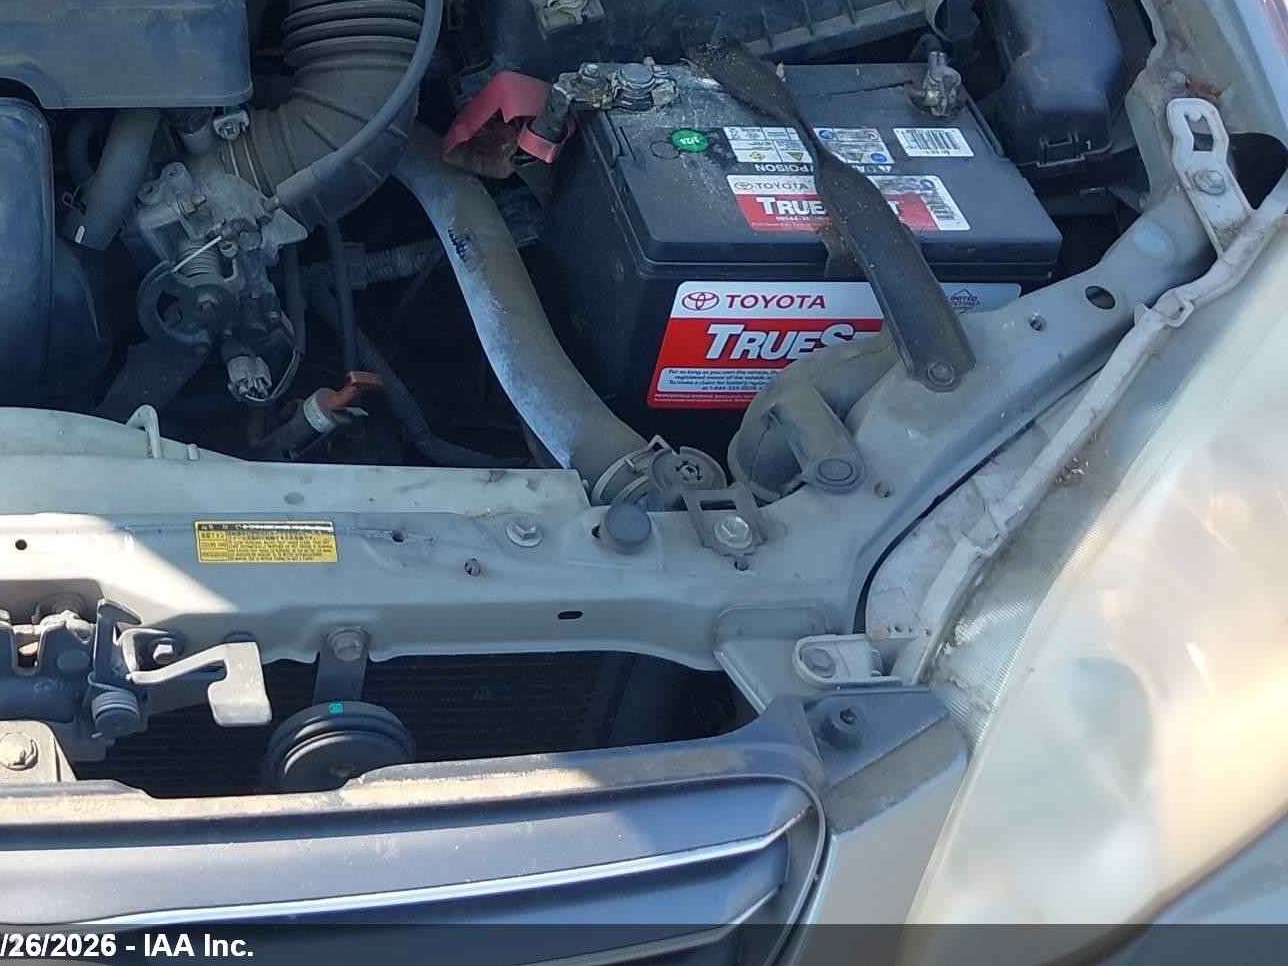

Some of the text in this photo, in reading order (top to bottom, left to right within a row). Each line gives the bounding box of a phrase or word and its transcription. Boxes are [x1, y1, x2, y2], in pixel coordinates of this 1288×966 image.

[753, 182, 809, 190] TOYOTA
[756, 197, 826, 215] TRUE
[725, 294, 826, 309] TOYOTA
